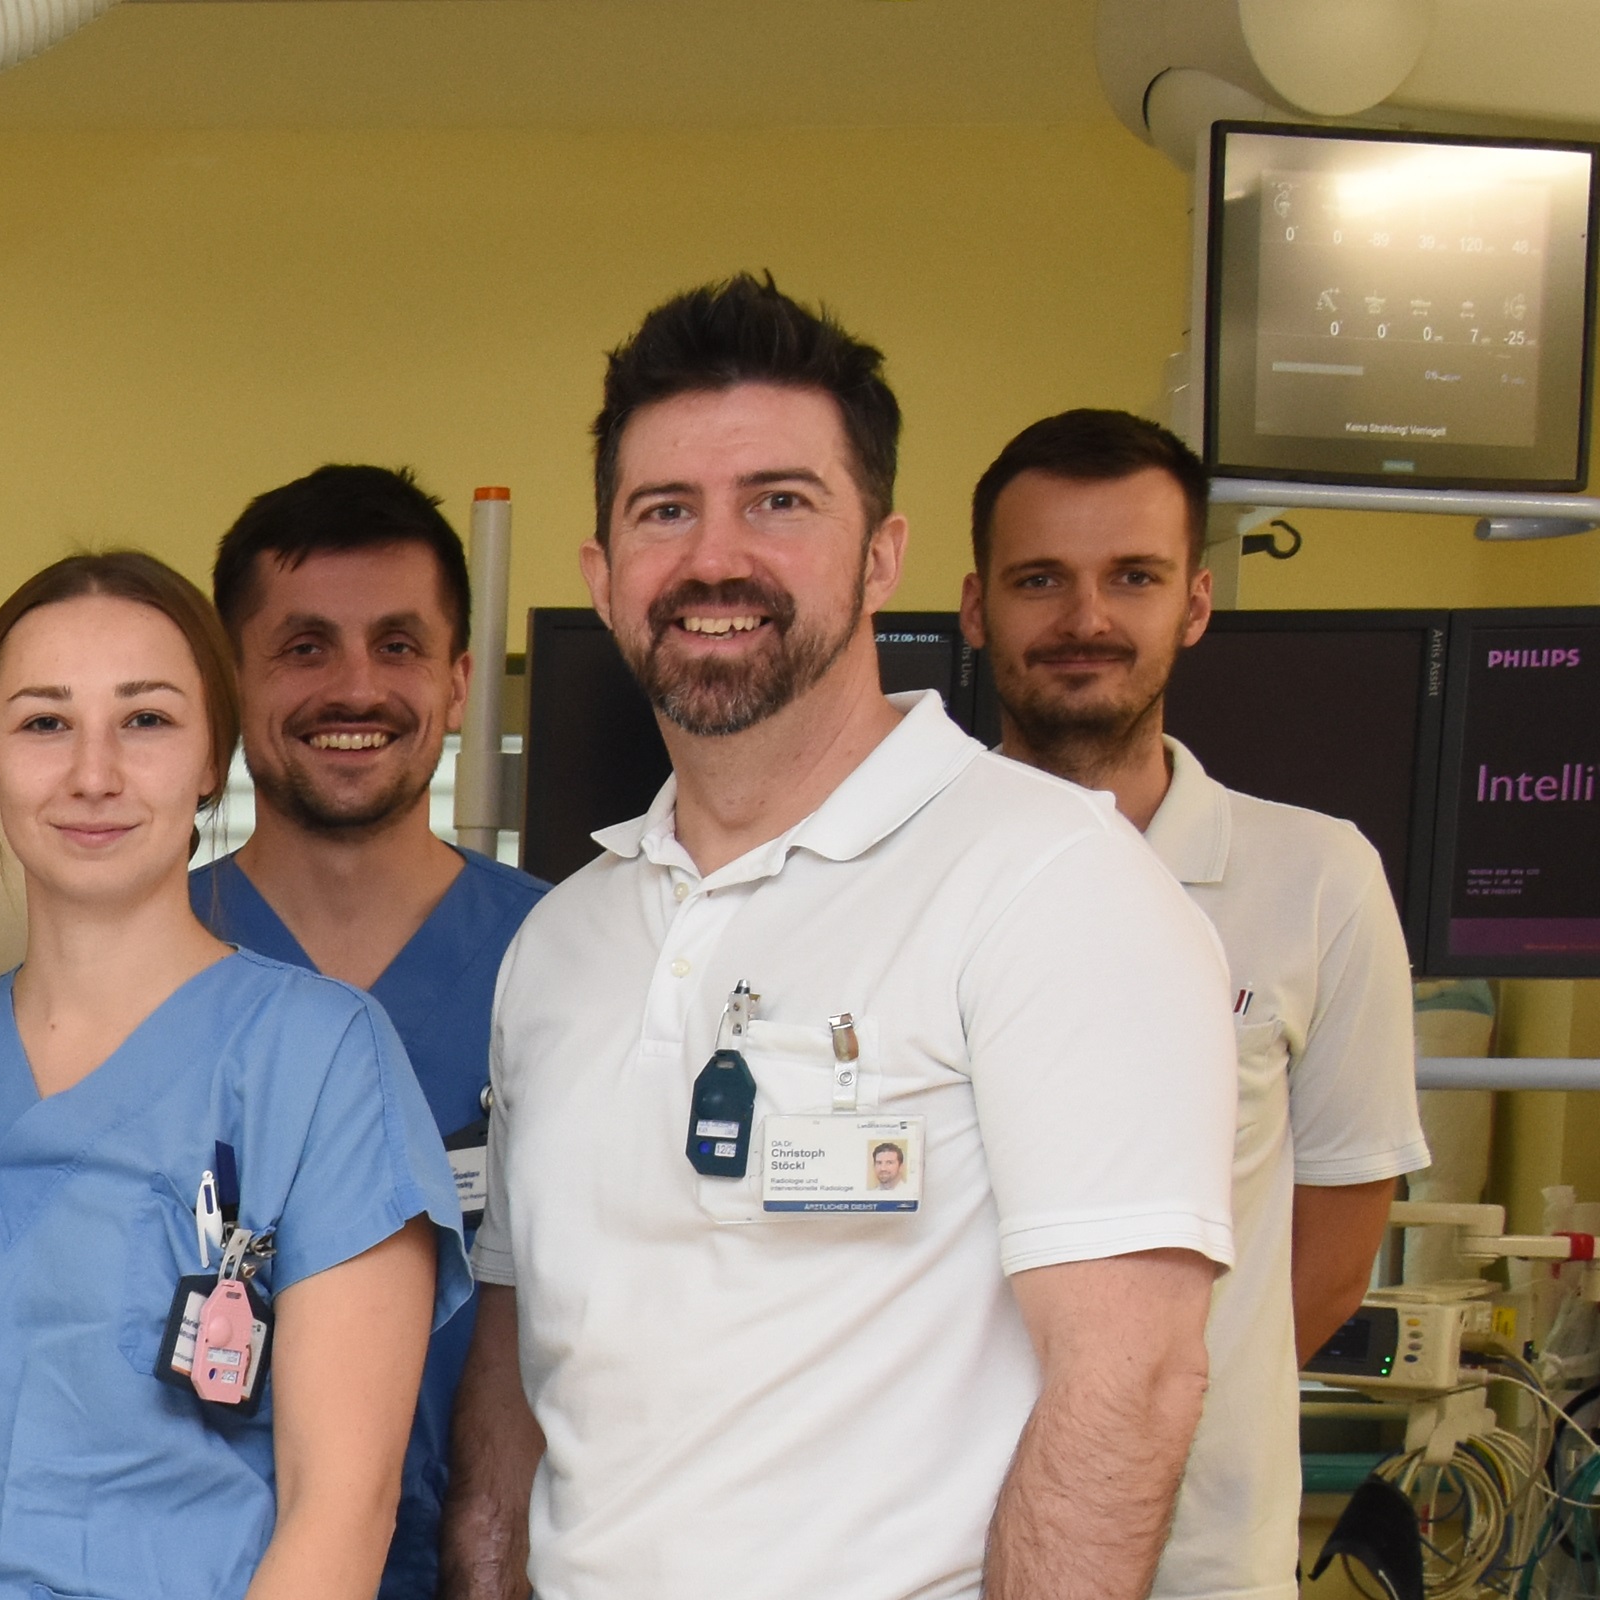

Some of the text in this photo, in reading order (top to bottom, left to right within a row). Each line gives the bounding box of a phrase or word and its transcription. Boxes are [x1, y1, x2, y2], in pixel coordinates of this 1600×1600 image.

[1488, 648, 1581, 669] PHILIPS
[1428, 660, 1441, 696] Assist
[1477, 763, 1600, 802] Intelli
[771, 1148, 825, 1160] Christoph
[771, 1160, 806, 1170] Stöckl
